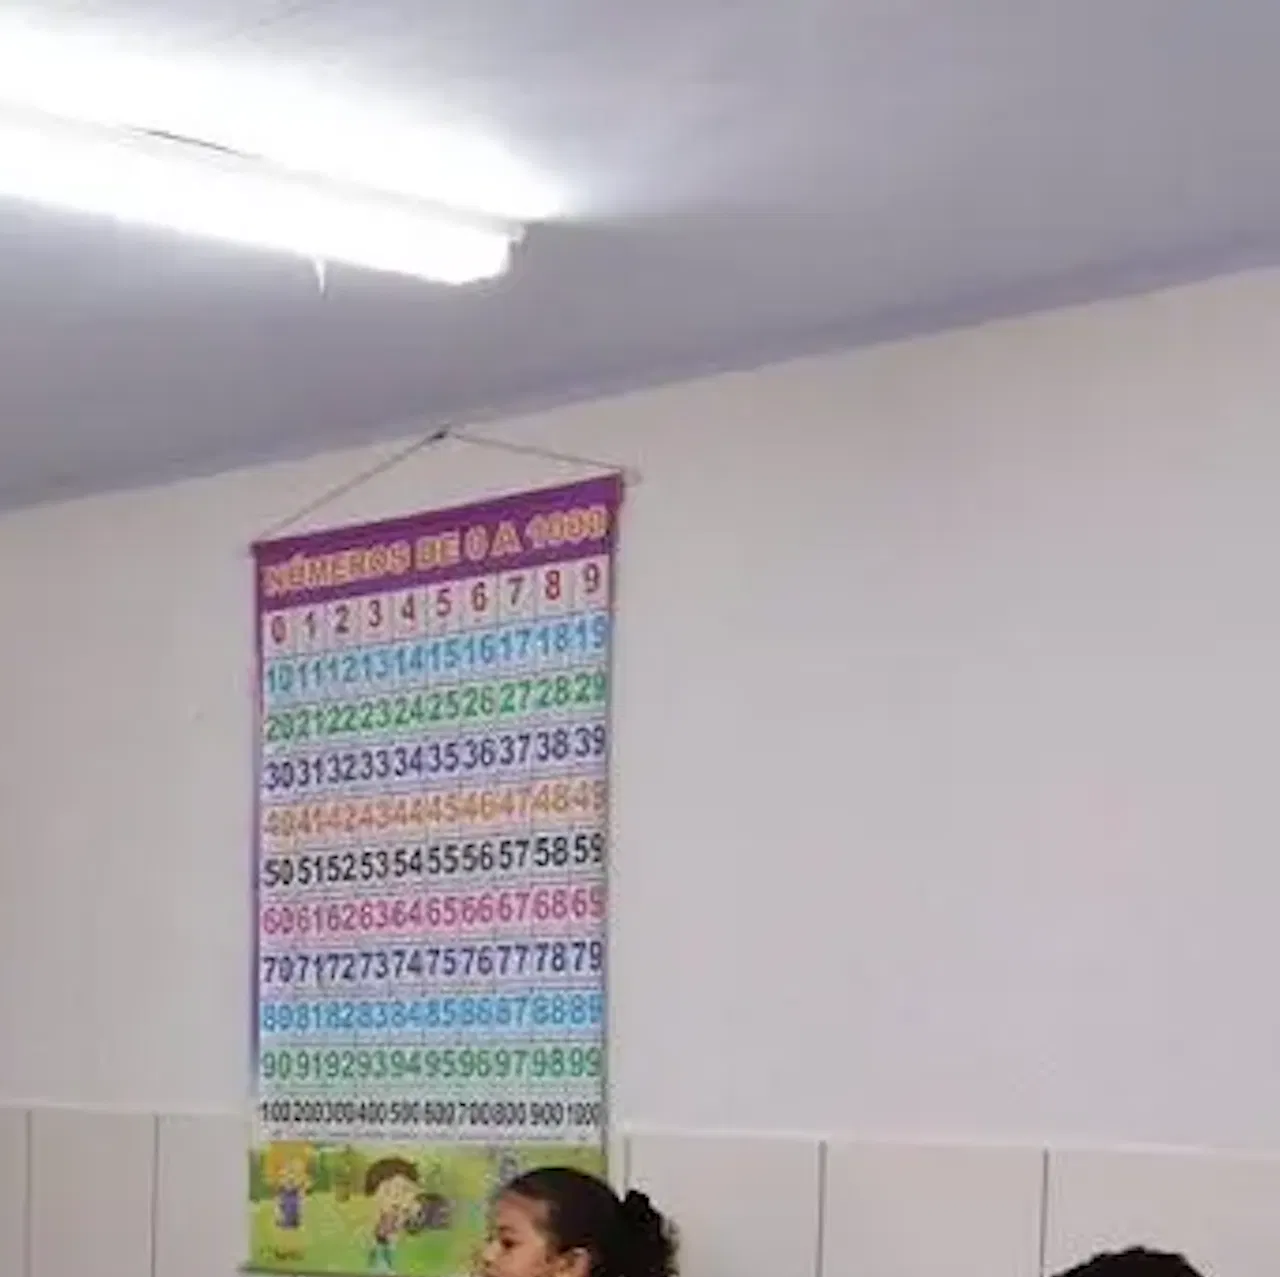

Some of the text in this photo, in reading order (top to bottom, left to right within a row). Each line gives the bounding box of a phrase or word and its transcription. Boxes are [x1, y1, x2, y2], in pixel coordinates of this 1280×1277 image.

[271, 564, 600, 643] 0 1 2 3 4 5 6 7 8 9
[297, 657, 323, 685] 11
[327, 653, 355, 681] 12
[361, 649, 388, 677] 13
[395, 644, 421, 672] 14
[428, 639, 458, 668] 15
[464, 634, 494, 663] 16
[500, 630, 530, 659] 17
[537, 625, 568, 654] 18
[297, 708, 323, 735] 21
[327, 705, 355, 731] 22
[361, 701, 388, 727] 23
[395, 697, 421, 724] 24
[428, 693, 458, 720] 25
[464, 689, 494, 716] 26
[500, 684, 530, 712] 27
[537, 680, 568, 708] 28
[574, 676, 605, 703] 29
[266, 726, 605, 787] 30 31 32 33 34 35 36 37 38 39
[264, 834, 603, 886] 50 51 52 53 54 55 56 57 58 59
[263, 942, 602, 982] 70 71 72 73 74 75 76 77 78 79
